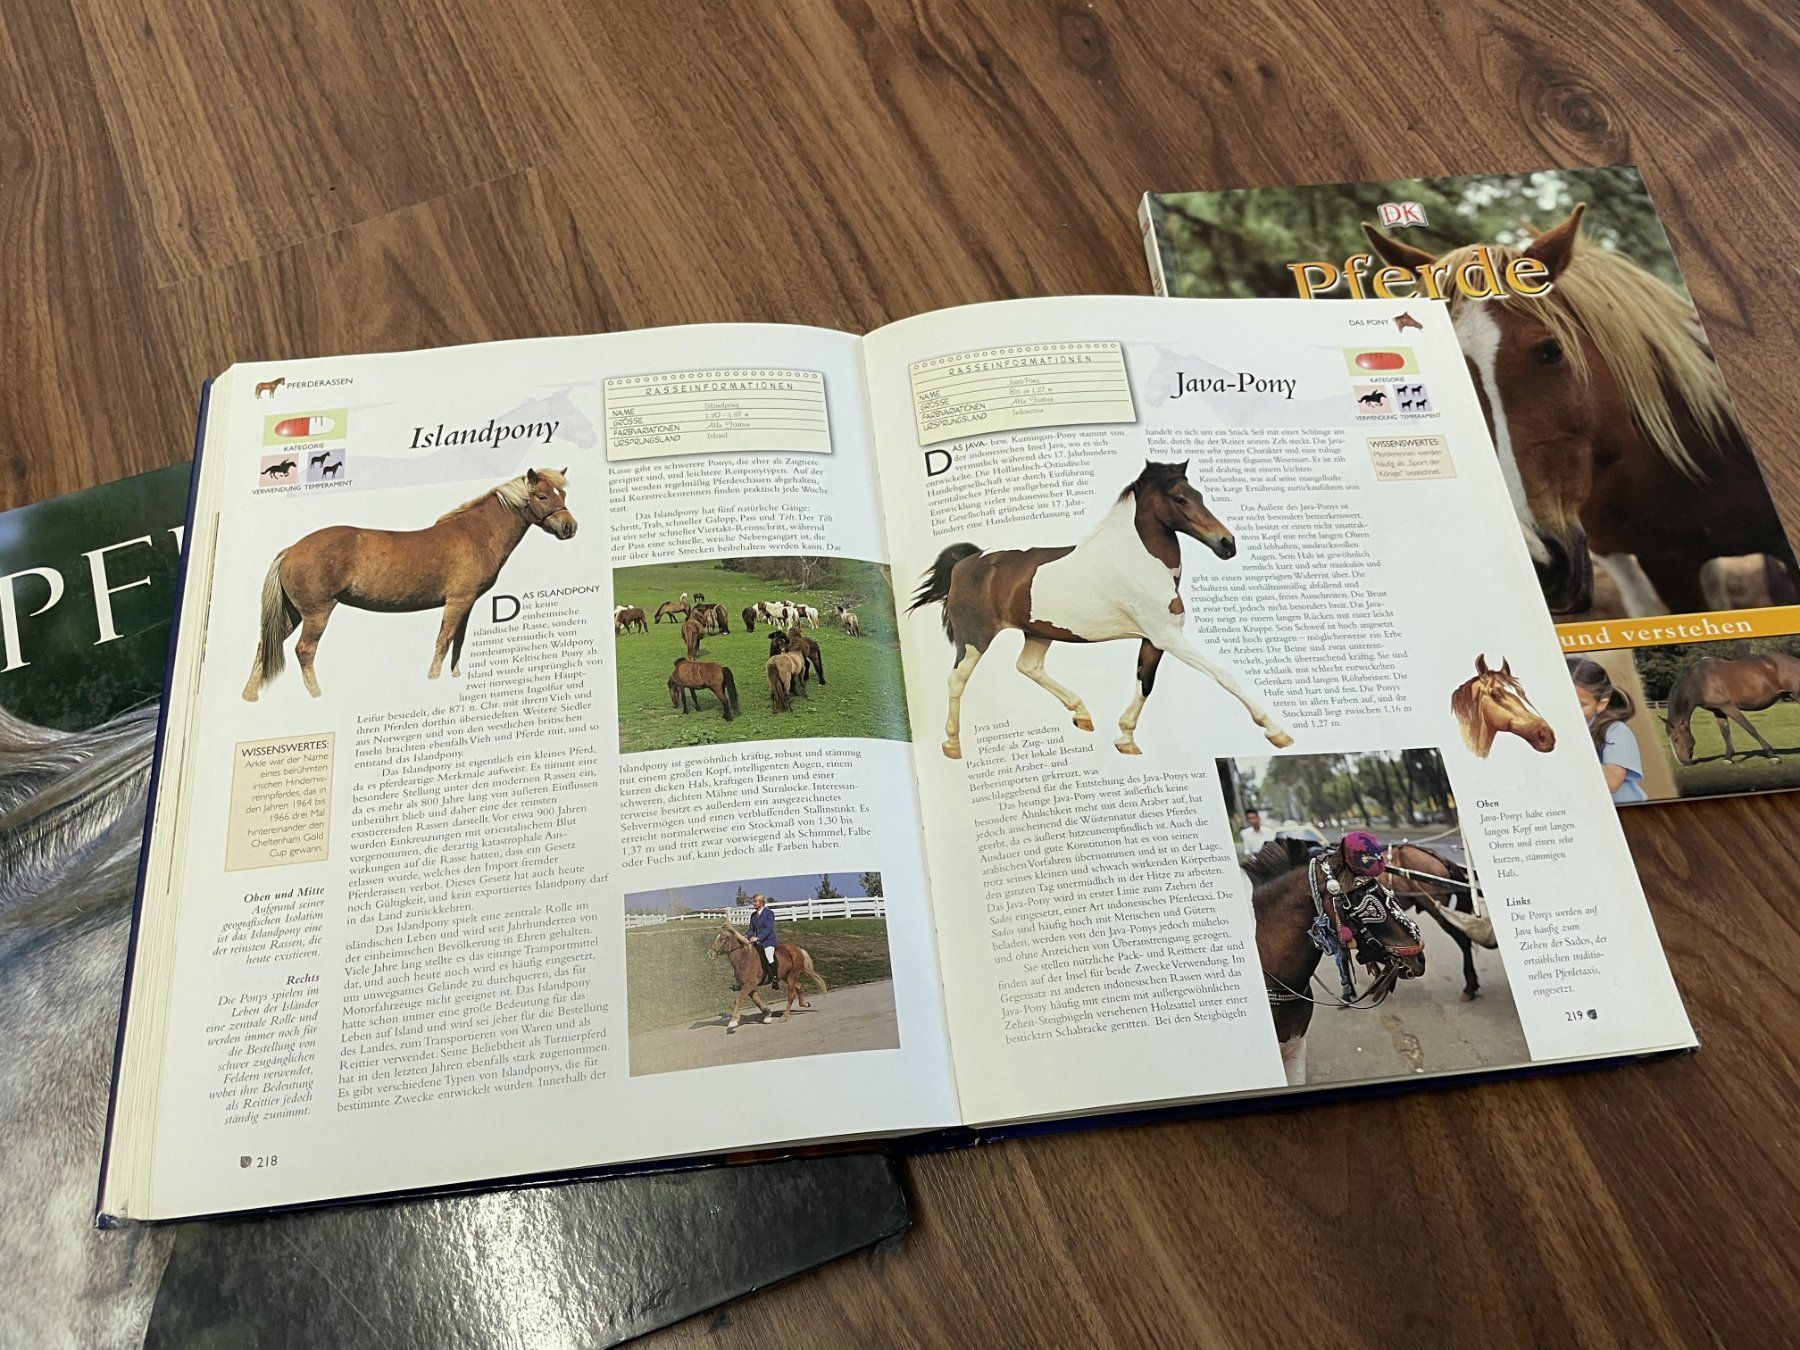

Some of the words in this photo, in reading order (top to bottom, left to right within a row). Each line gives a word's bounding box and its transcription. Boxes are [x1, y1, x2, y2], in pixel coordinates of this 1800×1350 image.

[1382, 204, 1420, 223] DK
[1287, 246, 1552, 300] Pferde
[948, 355, 1092, 376] RASSEINFORMATIONEN
[287, 378, 353, 389] PFERDERASSEN
[646, 382, 794, 396] RASSEINFORMATIONEN
[1170, 371, 1296, 400] Java-Pony
[920, 390, 940, 400] NAME
[612, 408, 635, 416] NAME
[922, 403, 986, 420] FARBVARIATIONEN
[614, 424, 680, 436] FARBVARIATIONEN
[923, 413, 987, 431] URSPRUNGSLAND
[409, 418, 560, 450] Islandpony
[614, 435, 681, 447] URSPRUNGSLAND
[284, 443, 324, 451] KATEGORIE
[965, 440, 988, 452] JAVA-
[1370, 438, 1440, 448] WISSENSWERTES:
[252, 485, 301, 495] VERWENDUNG
[305, 480, 352, 490] TEMPERAMENT
[0, 525, 186, 673] PF
[537, 585, 600, 598] ISLANDPONY
[1561, 627, 1611, 647] und
[1622, 618, 1753, 642] verstehen
[242, 740, 330, 757] WISSENSWERTES:
[1477, 799, 1499, 808] Oben
[1480, 811, 1522, 825] Java-Ponys
[1524, 809, 1543, 819] habe
[1545, 808, 1566, 817] einen
[1483, 826, 1509, 838] langen
[1512, 823, 1532, 836] Kopf
[1534, 822, 1548, 832] mit
[1549, 822, 1575, 833] langen
[250, 836, 300, 848] Cheltenham
[302, 832, 323, 842] Gold
[645, 846, 655, 854] m
[658, 841, 676, 852] und
[679, 840, 698, 851] tritt
[701, 841, 722, 849] zwar
[726, 833, 782, 848] vorwiegend
[784, 832, 795, 842] als
[798, 828, 846, 841] Schimmel,
[848, 826, 871, 838] Falbe
[1488, 839, 1514, 849] Ohren
[1516, 837, 1532, 847] und
[1534, 836, 1556, 846] einen
[1558, 834, 1573, 844] sehr
[621, 857, 643, 868] oder
[646, 854, 674, 865] Fuchs
[676, 852, 695, 863] auf,
[697, 851, 720, 861] kann
[721, 846, 754, 862] jedoch
[758, 845, 773, 856] alle
[777, 842, 808, 854] Farben
[1492, 854, 1524, 864] kurzen,
[1525, 850, 1566, 862] stämmigen
[243, 893, 270, 904] Oben
[274, 889, 293, 900] und
[296, 886, 324, 898] Mitte
[1507, 897, 1530, 906] Links
[251, 901, 295, 916] Aufgrund
[298, 899, 325, 910] seiner
[221, 916, 281, 934] geografischen
[284, 912, 323, 924] Isolation
[217, 933, 228, 944] ist
[231, 932, 247, 942] das
[250, 927, 301, 940] Islandpony
[304, 923, 323, 934] eine
[212, 947, 228, 957] der
[230, 942, 266, 955] reinsten
[308, 935, 322, 946] die
[245, 953, 271, 965] heute
[286, 974, 320, 986] Rechts
[1004, 1011, 1093, 1031] Zehen-Steigbügeln
[1096, 1007, 1148, 1021] versehenen
[1151, 999, 1196, 1014] Holzsattel
[1198, 998, 1222, 1009] unter
[1225, 995, 1248, 1006] einer
[1565, 1010, 1582, 1021] 219
[1005, 1030, 1052, 1044] bestickten
[1055, 1023, 1107, 1038] Schabracke
[1110, 1020, 1149, 1036] geritten.
[1155, 1016, 1171, 1027] Bei
[1174, 1015, 1191, 1025] den
[1194, 1008, 1247, 1024] Steigbügeln
[338, 1087, 349, 1098] Es
[352, 1084, 373, 1100] gibt
[377, 1077, 441, 1094] verschiedene
[446, 1074, 475, 1088] Typen
[478, 1072, 498, 1081] von
[502, 1064, 562, 1078] Islandponys,
[564, 1058, 580, 1070] die
[583, 1056, 598, 1068] für
[337, 1096, 390, 1112] bestimmte
[393, 1091, 434, 1106] Zwecke
[437, 1083, 490, 1100] entwickelt
[538, 1072, 586, 1088] Innerhalb
[590, 1071, 606, 1082] der
[257, 1156, 278, 1168] 218
